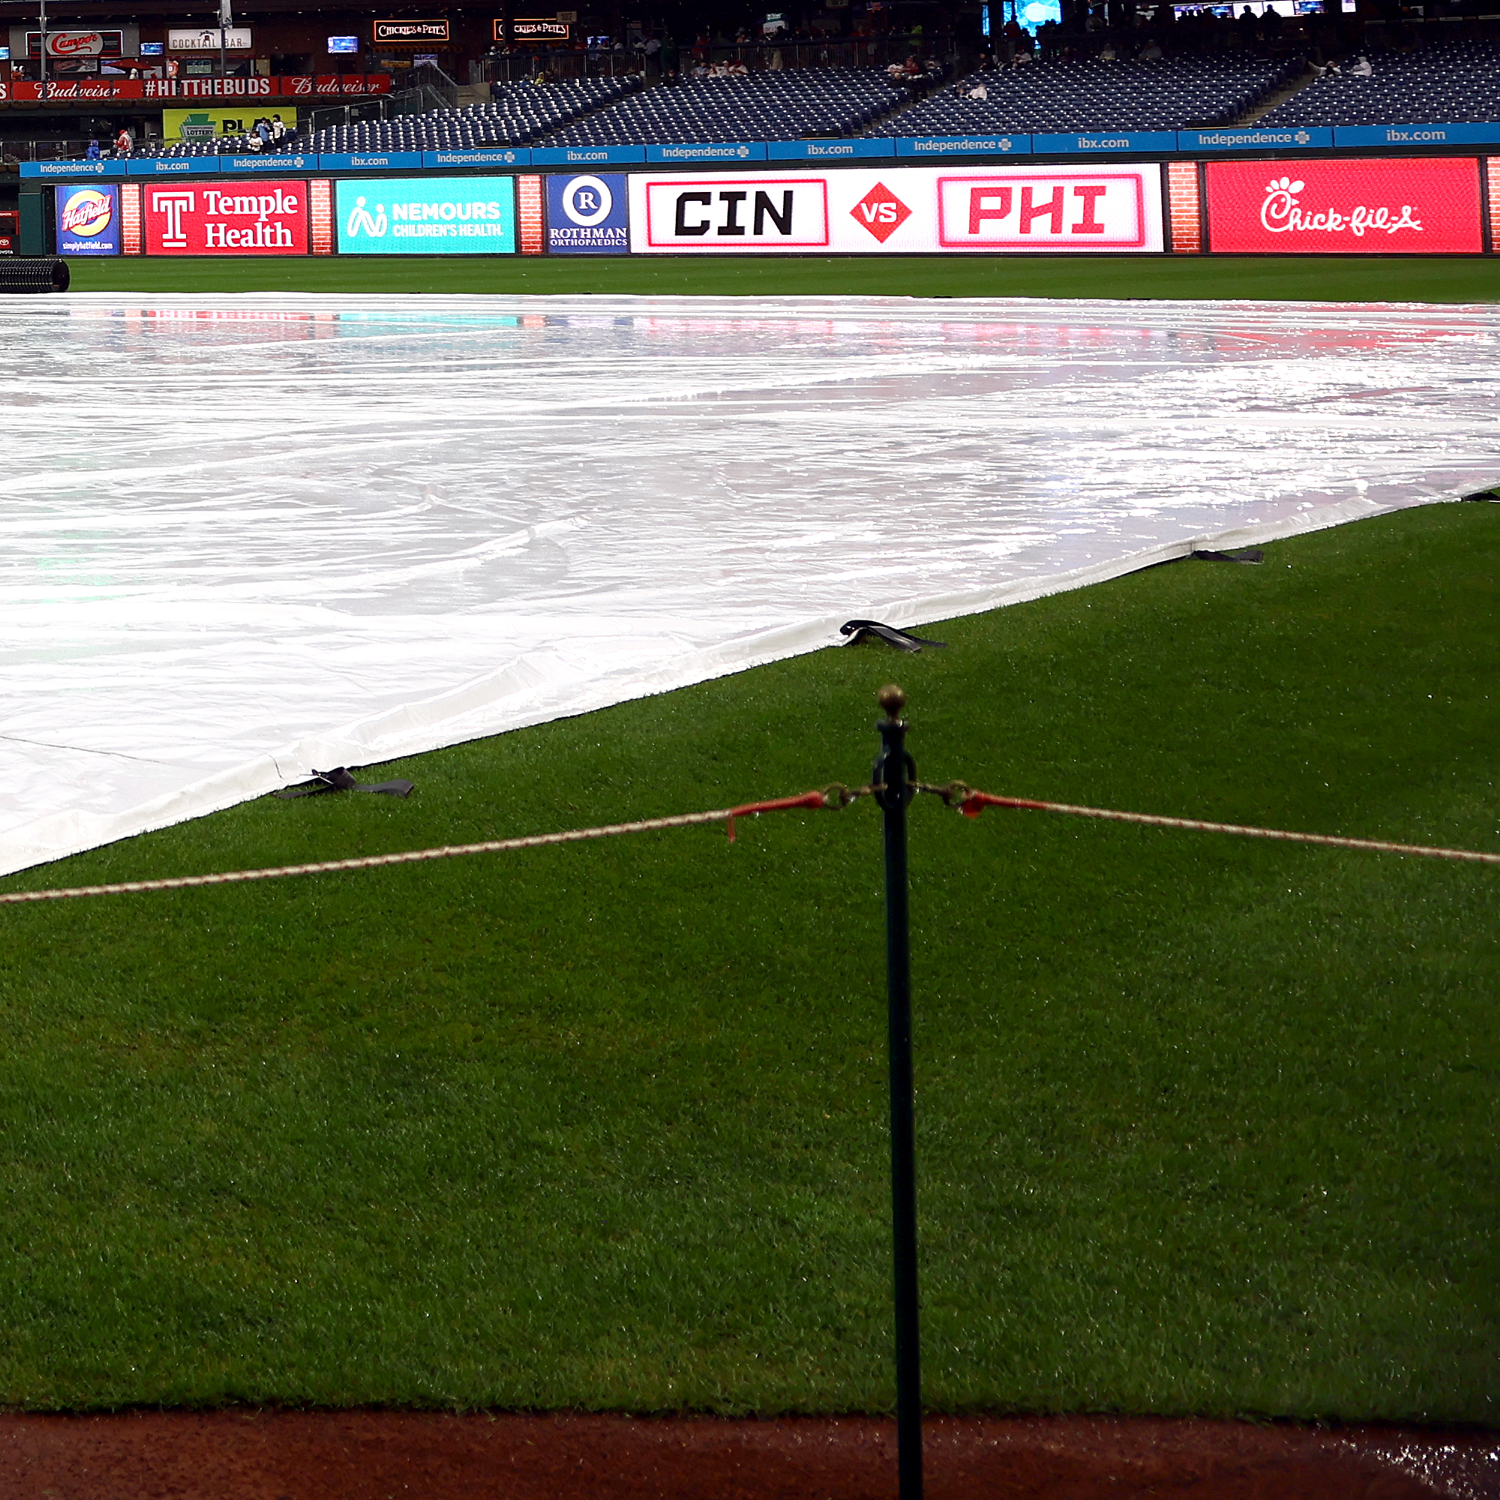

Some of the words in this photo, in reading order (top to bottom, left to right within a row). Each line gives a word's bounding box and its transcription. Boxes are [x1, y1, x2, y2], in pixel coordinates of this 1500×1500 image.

[51, 32, 99, 54] Campo's
[172, 38, 216, 49] COCKTAIL
[33, 82, 121, 100] Budweiser
[233, 157, 293, 168] Independence
[351, 155, 389, 166] ibx.com
[437, 152, 502, 164] Independence
[567, 150, 608, 161] ibx.com
[40, 163, 94, 174] Independence
[155, 161, 190, 171] ibx.com
[203, 188, 298, 222] Temple
[577, 192, 598, 210] R
[62, 195, 113, 231] Hatfield
[392, 201, 500, 221] NEMOURS
[674, 190, 793, 236] CIN
[860, 202, 898, 223] VS
[968, 185, 1108, 235] PHI
[1260, 188, 1424, 237] Chick-fil-A
[204, 222, 294, 248] Health
[392, 223, 458, 238] CHILDREN'S
[550, 227, 627, 238] ROTHMAN
[550, 238, 628, 247] ORTHOPAEDICS
